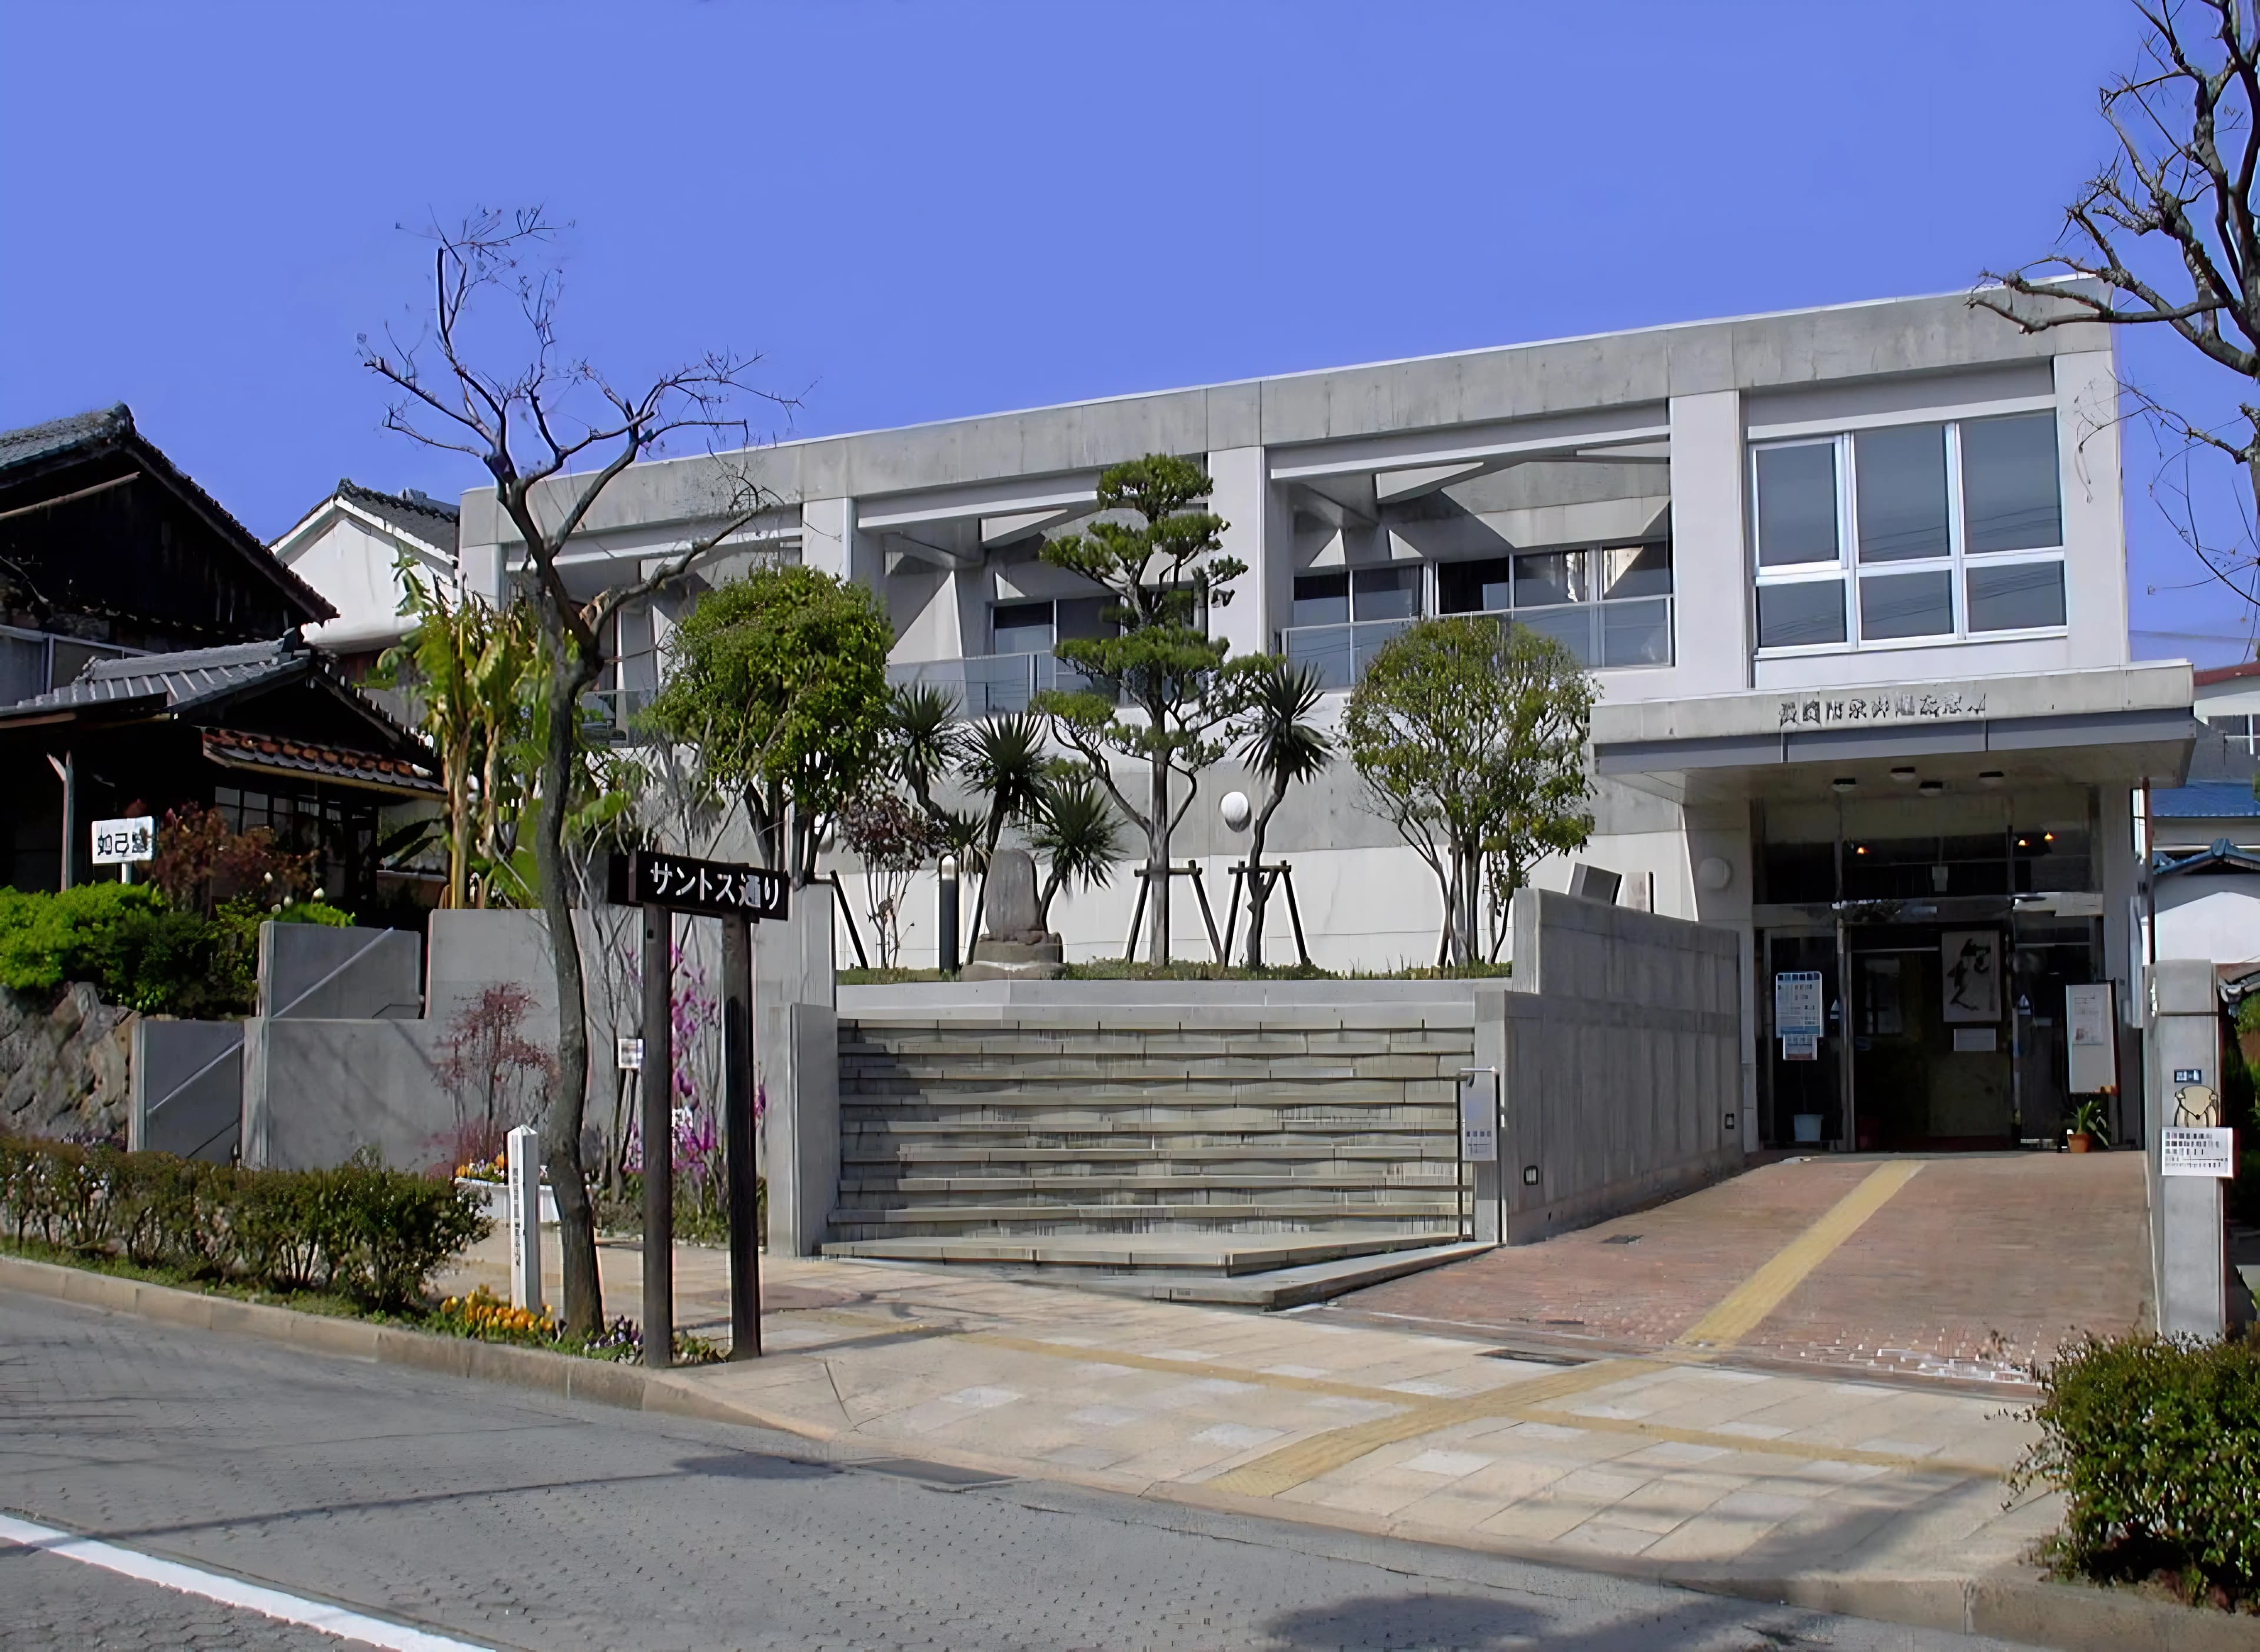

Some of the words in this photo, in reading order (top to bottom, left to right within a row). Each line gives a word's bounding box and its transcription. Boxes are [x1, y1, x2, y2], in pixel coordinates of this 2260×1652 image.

[650, 861, 779, 910] サントス通り
